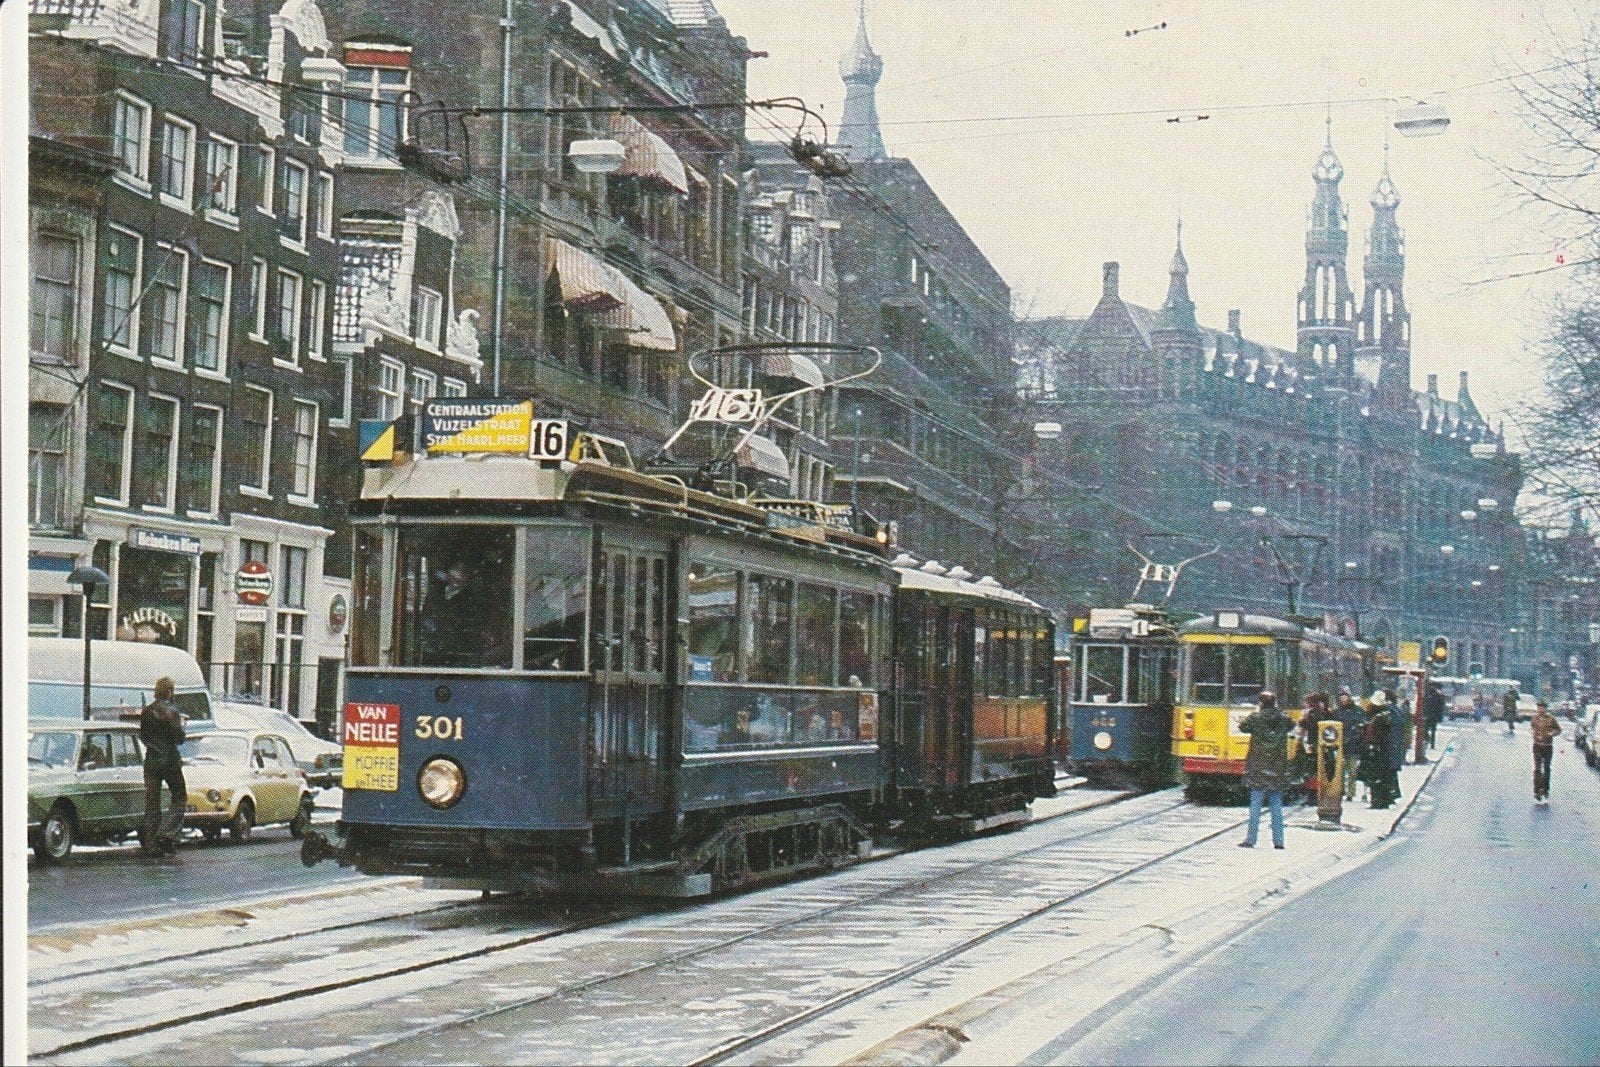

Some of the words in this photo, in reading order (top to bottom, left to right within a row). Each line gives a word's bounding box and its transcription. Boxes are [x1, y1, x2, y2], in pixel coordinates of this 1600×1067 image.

[427, 403, 528, 416] CENTRAALSTATION
[703, 390, 753, 422] 16
[533, 421, 563, 456] 16
[357, 706, 387, 720] VAN
[345, 722, 398, 743] NELLE
[415, 715, 463, 740] 301
[356, 756, 396, 771] KOFFIE
[365, 773, 395, 788] THEE
